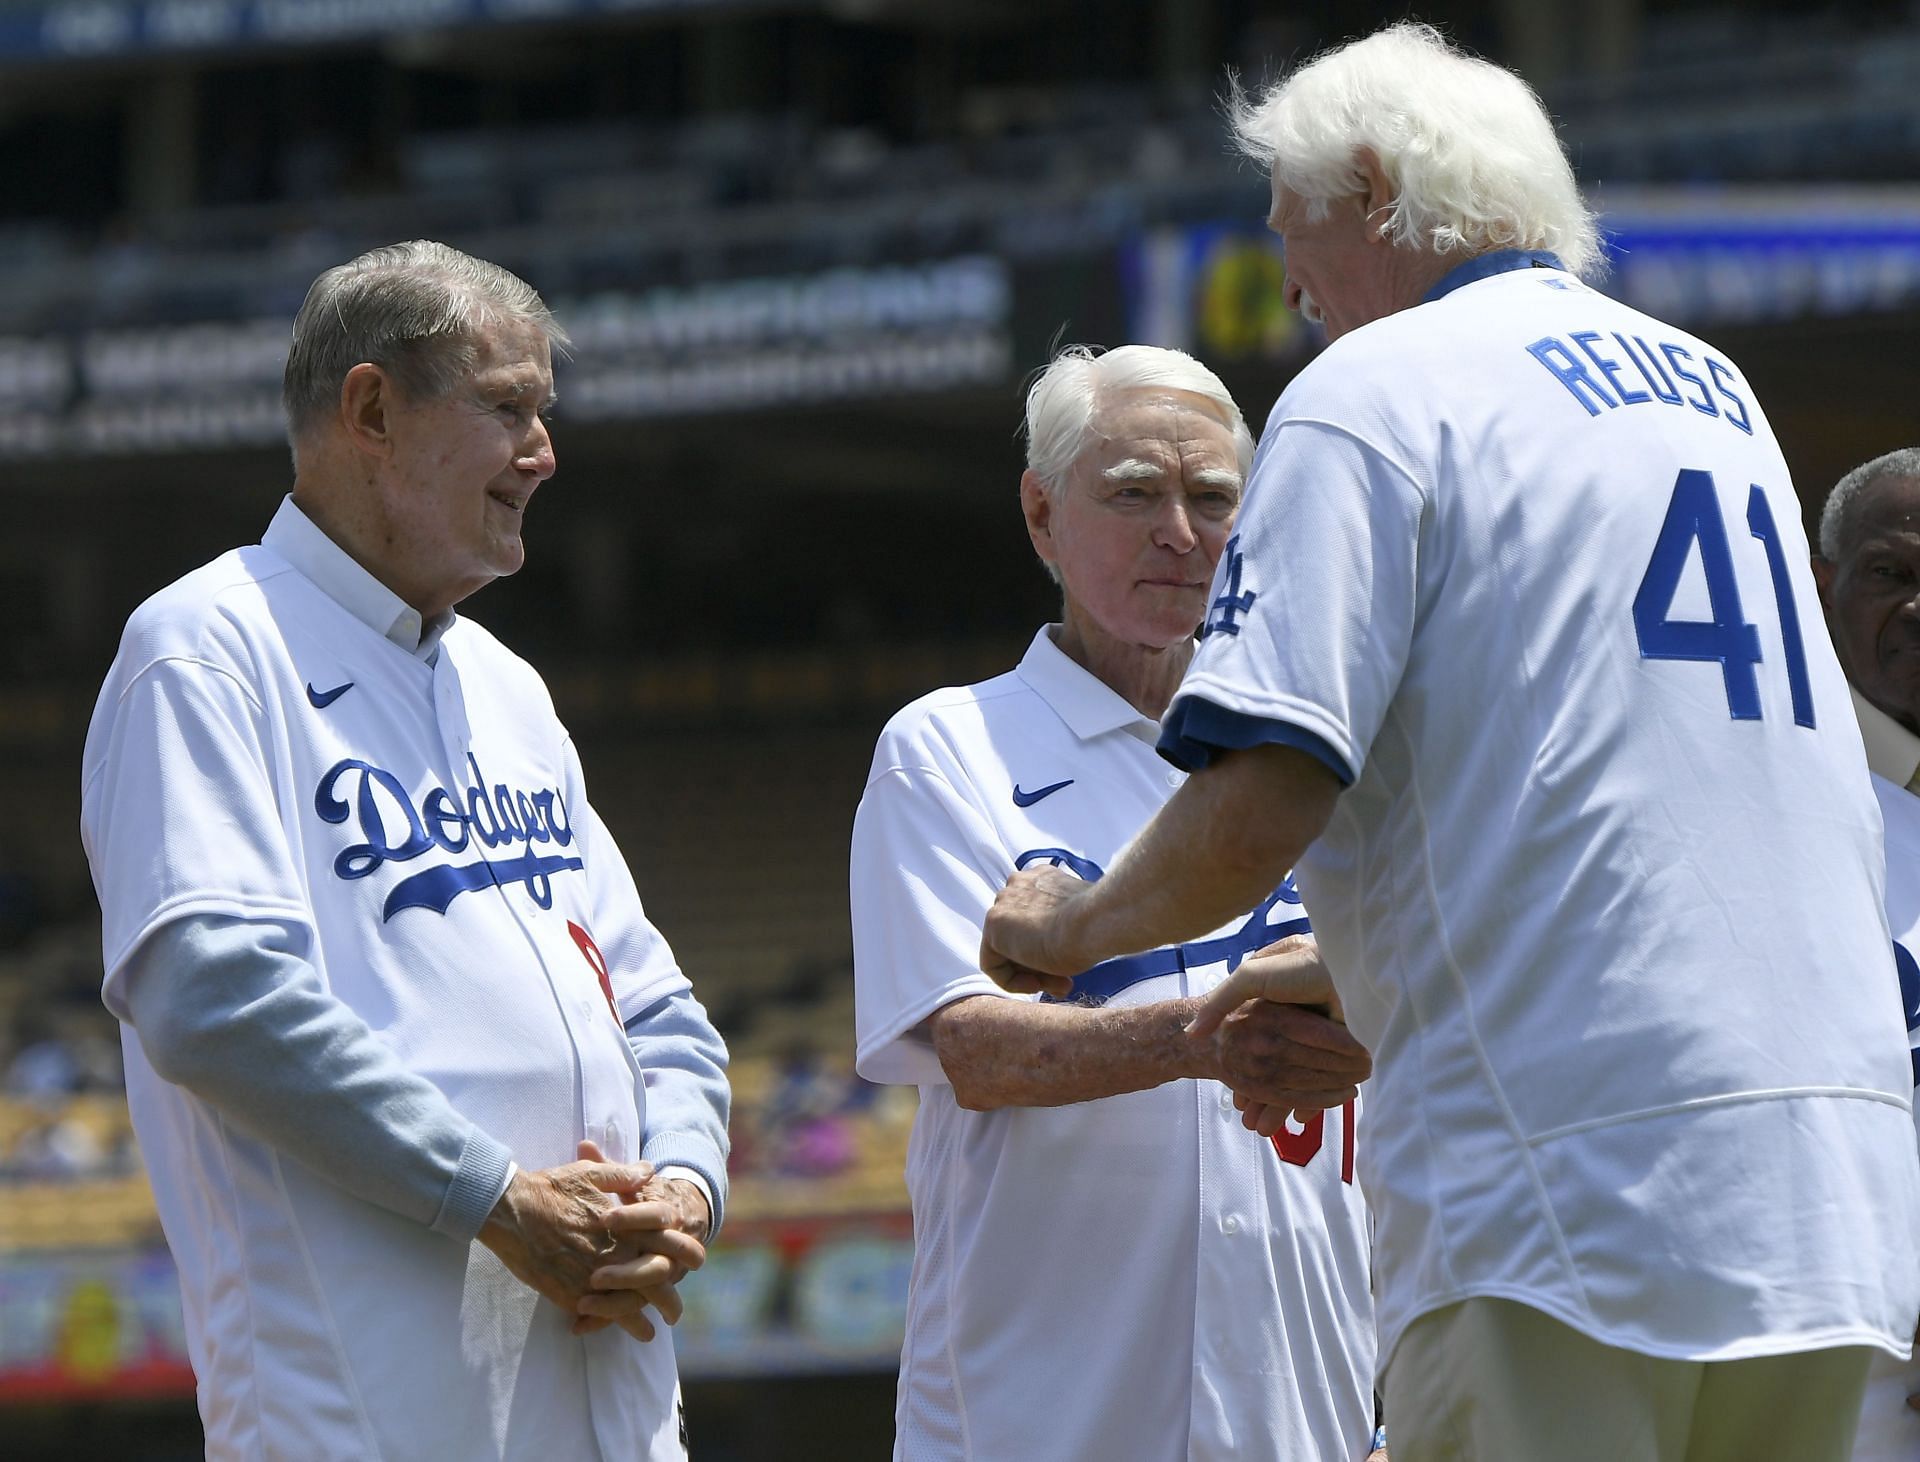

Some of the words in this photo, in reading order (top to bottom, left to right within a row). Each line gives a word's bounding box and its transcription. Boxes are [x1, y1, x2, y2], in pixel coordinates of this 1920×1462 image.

[1524, 330, 1754, 436] REUSS
[1632, 468, 1817, 730] 41
[314, 751, 574, 911] Dodger
